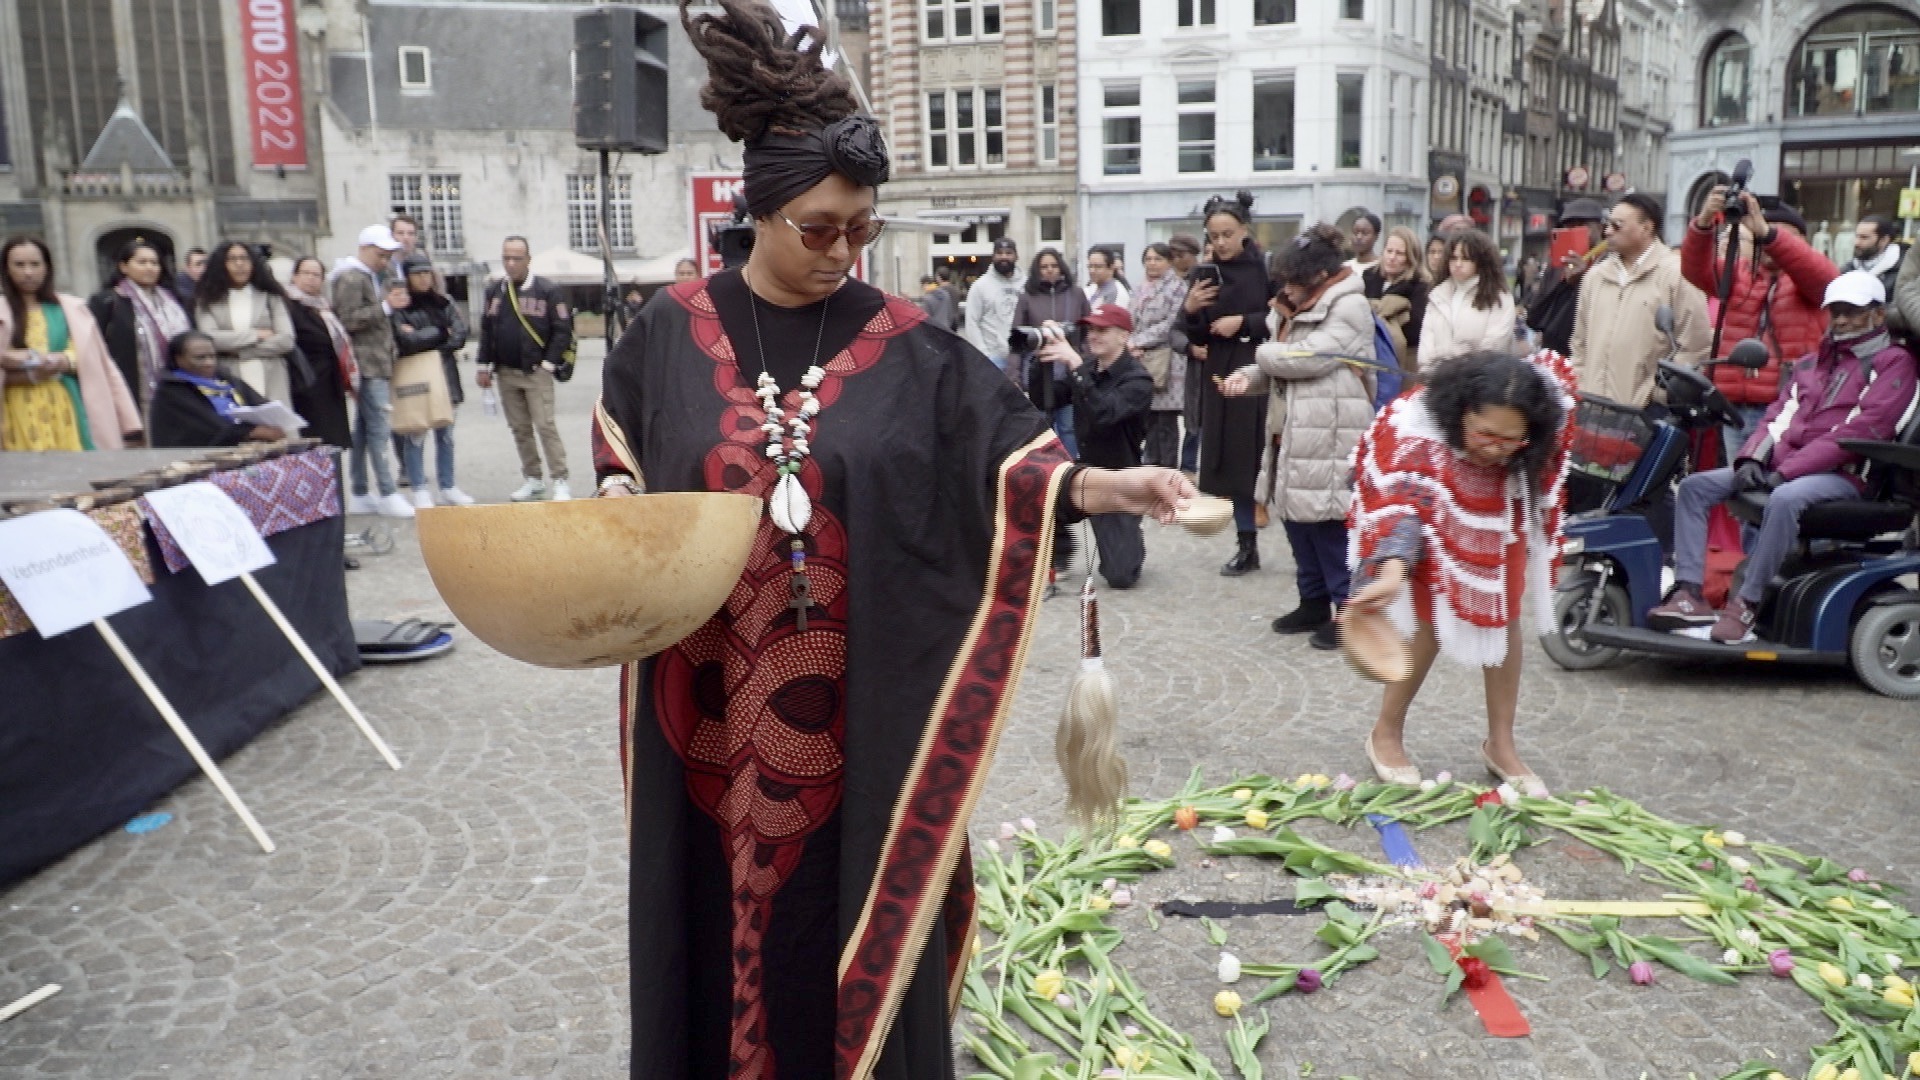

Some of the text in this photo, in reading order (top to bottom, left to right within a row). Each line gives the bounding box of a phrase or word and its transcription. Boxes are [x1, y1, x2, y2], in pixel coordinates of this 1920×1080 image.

[249, 0, 297, 149] OTO 2022
[7, 541, 111, 579] Verbondenheid
